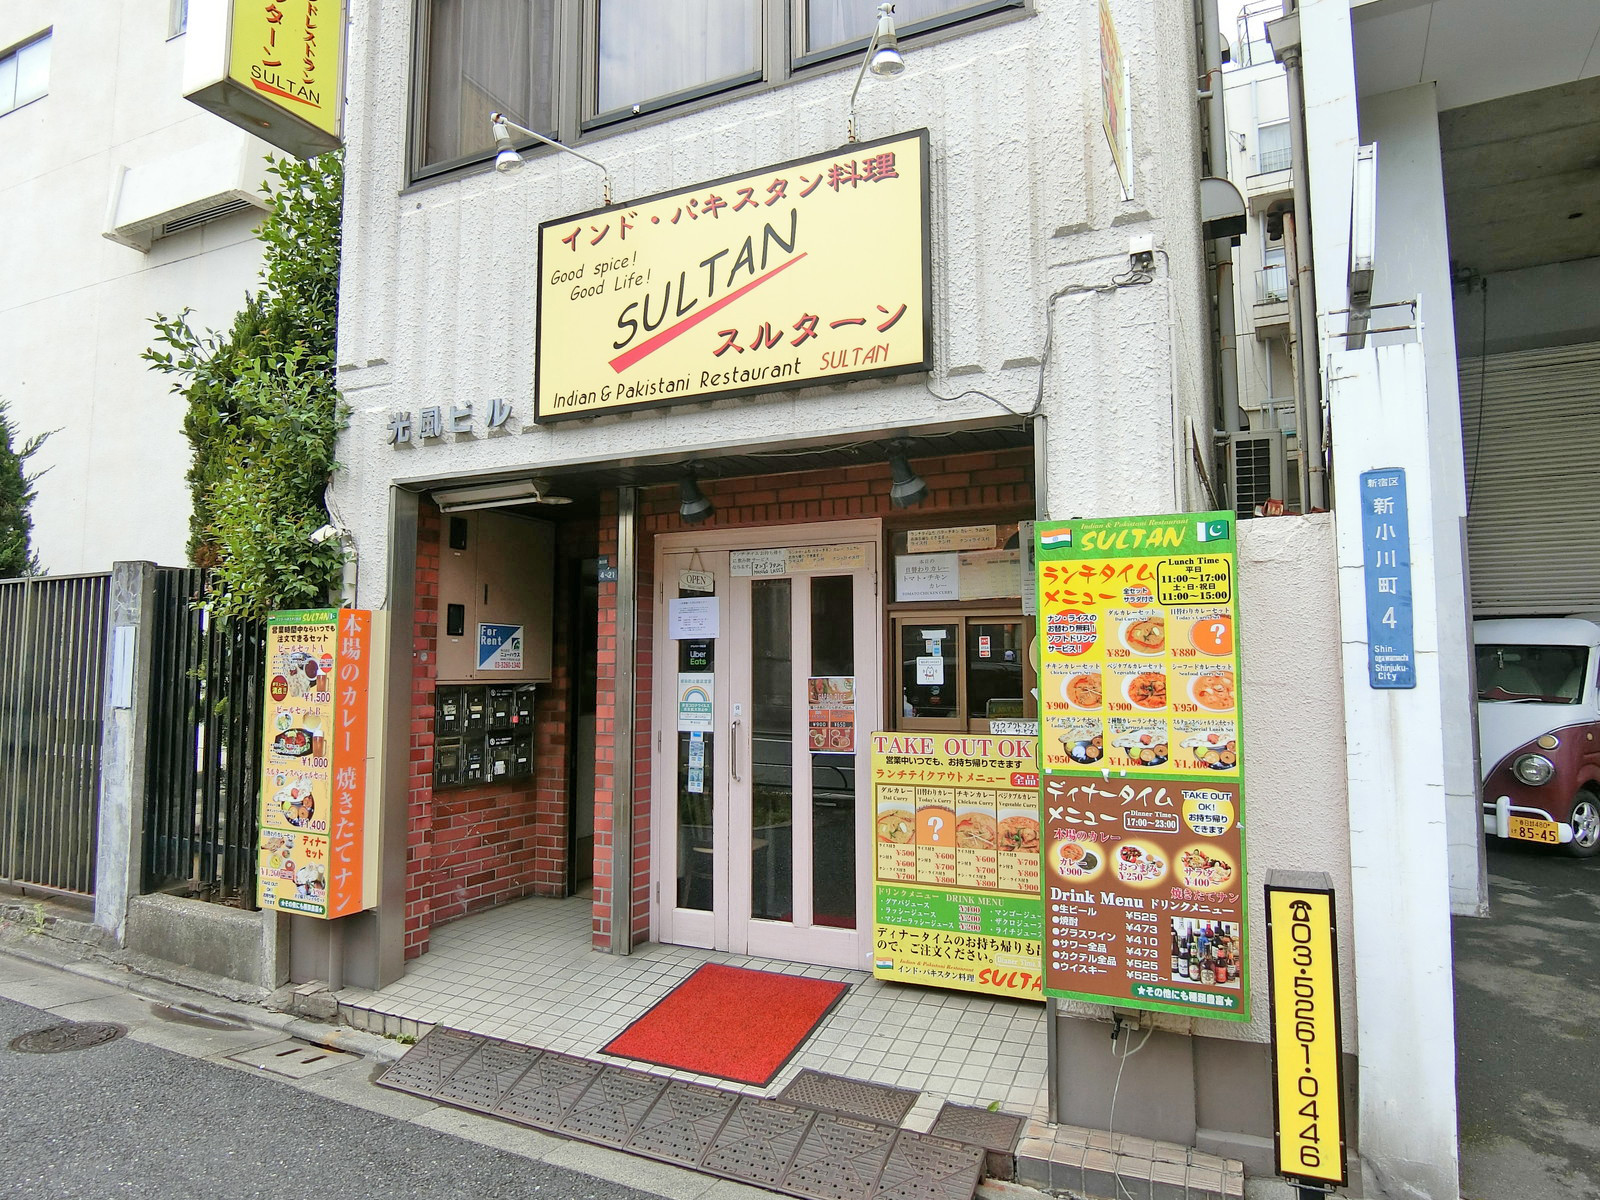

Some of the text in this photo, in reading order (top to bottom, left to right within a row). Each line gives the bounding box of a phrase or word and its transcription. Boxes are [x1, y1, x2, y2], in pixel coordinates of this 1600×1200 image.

[262, 0, 286, 66] ターン
[302, 0, 318, 84] ドレストラン
[250, 65, 320, 104] SULTAN
[561, 151, 899, 251] インド・パキスタン料理
[551, 251, 637, 285] Good spice!
[612, 208, 797, 350] SULTAN
[570, 269, 652, 301] Good Life!
[713, 303, 908, 358] スルターン
[553, 343, 890, 409] Indian & Pakistani Restaurant SULTAN
[387, 398, 512, 445] 光風ビル
[1367, 476, 1399, 488] 新宿区
[1114, 520, 1147, 528] Pakistani
[1149, 518, 1189, 526] Restaurant
[1081, 526, 1187, 551] SULTAN
[1043, 563, 1155, 585] ランチタイム
[686, 575, 707, 586] OPEN
[1123, 587, 1148, 595] 全セット
[1043, 589, 1117, 607] メニュー
[1123, 595, 1154, 603] サラダ付き
[302, 612, 329, 622] SULTAN
[1047, 614, 1097, 622] ナン・ライスの
[271, 625, 336, 634] 営業時間中ならいつでも
[481, 625, 497, 636] For
[277, 634, 329, 643] 注文できるセット
[480, 635, 502, 645] Rent
[1047, 634, 1097, 643] ソフトドリンク
[1106, 648, 1131, 657] ¥820
[1170, 648, 1196, 657] ¥880
[1375, 663, 1410, 673] Shinjuku-
[1378, 672, 1397, 681] City
[341, 613, 362, 752] 本場のカレー
[1046, 702, 1069, 710] ¥900
[1108, 702, 1132, 711] ¥900
[1173, 703, 1198, 712] ¥950
[874, 736, 1032, 758] TAKE OUT OK
[886, 755, 1022, 769] 営業中いつでも、お持ち帰りできます
[1047, 755, 1070, 764] ¥950
[876, 769, 1039, 786] ランチテイクアウトメニュー 全品
[1047, 781, 1173, 807] ディナータイム
[1182, 791, 1231, 801] TAKE OUT
[1048, 806, 1118, 826] メニュー
[1188, 813, 1228, 823] お持ち帰り
[1193, 824, 1225, 834] できます
[1520, 827, 1557, 841] 85-45
[335, 767, 356, 912] 焼きたてナン
[1054, 828, 1121, 842] 本場のカレー
[305, 848, 323, 859] セット
[935, 852, 954, 860] ¥600
[976, 855, 995, 863] ¥600
[935, 863, 954, 871] ¥700
[1017, 859, 1038, 867] ¥700
[1060, 858, 1087, 866] カレー
[1118, 862, 1158, 873] おつまみ
[1018, 870, 1038, 878] ¥800
[1184, 867, 1215, 877] サラダ
[1018, 883, 1038, 891] ¥900
[878, 888, 939, 899] ドリンクメニュー
[1050, 887, 1144, 908] Drink Menu
[1170, 886, 1240, 903] 焼きたてナン
[946, 894, 1005, 906] DRINK MENU
[1059, 904, 1097, 916] 生ビール
[1151, 899, 1235, 914] ドリンクメニュー
[885, 907, 937, 918] ラッシージュース
[1125, 911, 1158, 921] ¥525
[1059, 916, 1078, 926] 焼酎
[1125, 923, 1158, 934] ¥473
[1059, 928, 1116, 941] グラスワイン
[1125, 935, 1158, 946] ¥410
[877, 940, 993, 964] ので、ご注文ください。
[1060, 940, 1107, 953] サワー全品
[1125, 947, 1158, 958] ¥473
[1060, 951, 1117, 966] カクテル全品
[1060, 962, 1107, 974] ウイスキー
[1126, 959, 1158, 970] ¥525
[898, 966, 975, 982] インド・パキスタン料理
